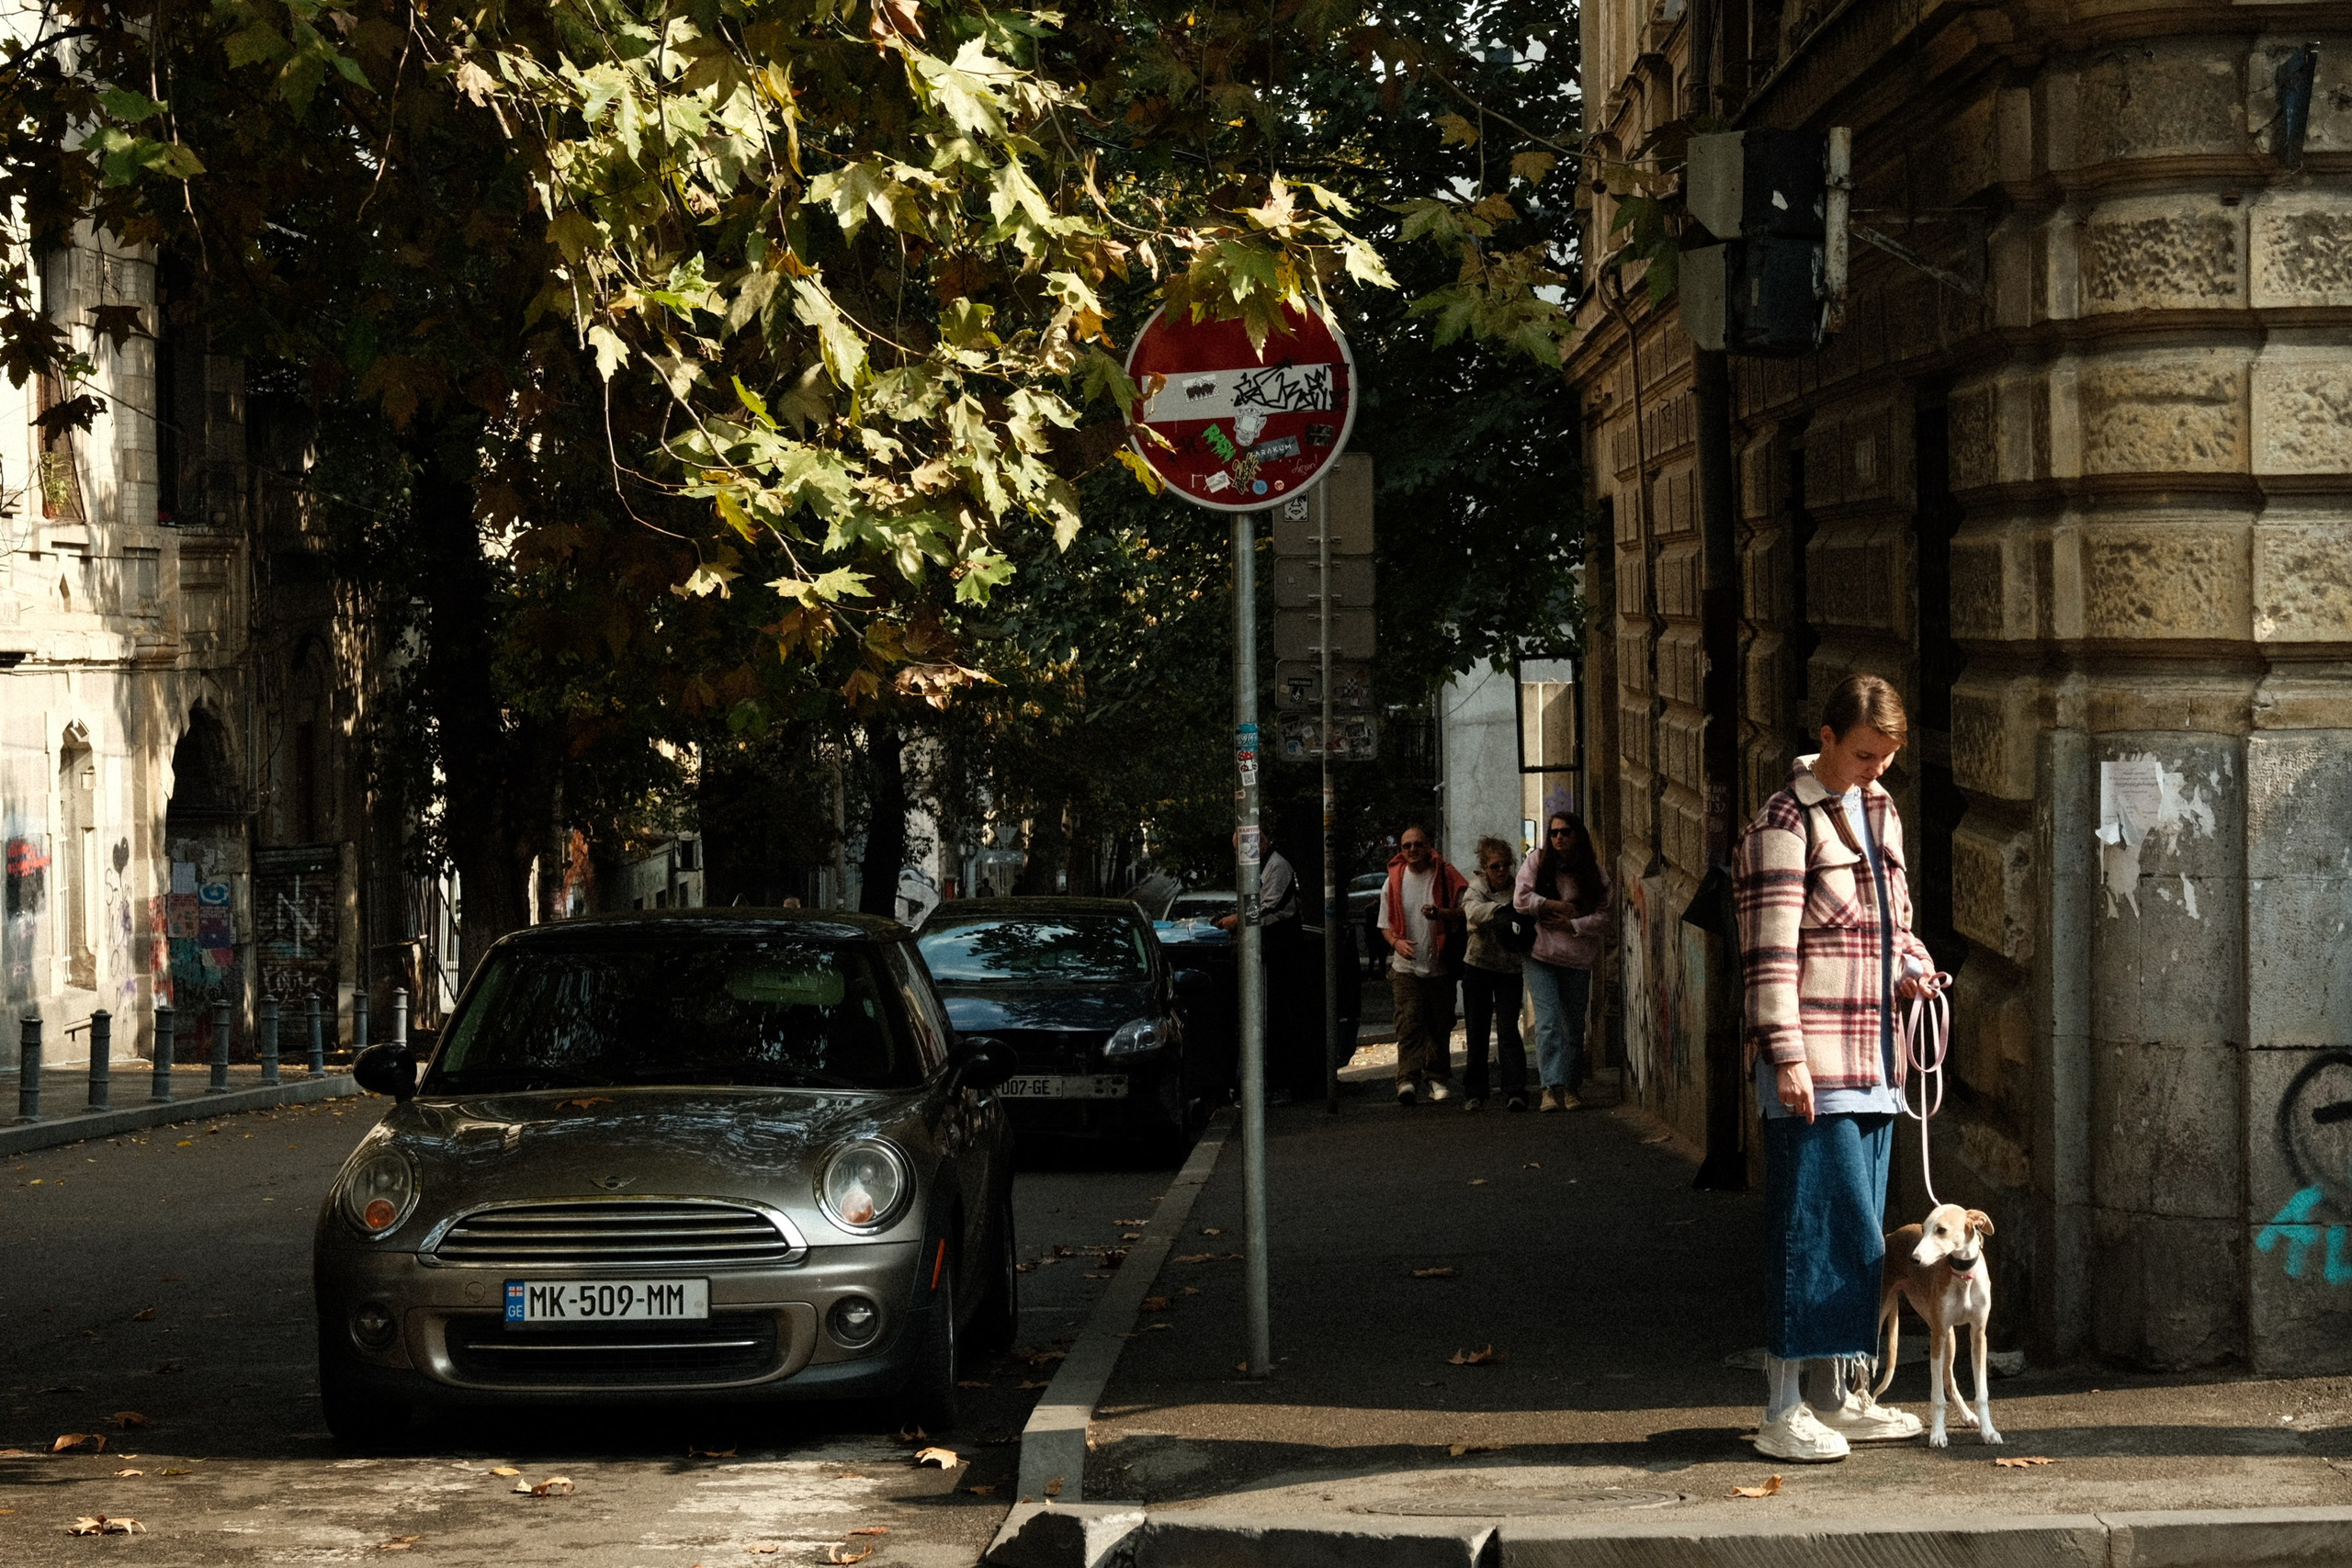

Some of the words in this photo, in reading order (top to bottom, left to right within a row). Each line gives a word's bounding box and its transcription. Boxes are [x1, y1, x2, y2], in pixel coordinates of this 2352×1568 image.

[1254, 443, 1292, 458] ARAKUM
[997, 1079, 1051, 1095] -007-GE
[529, 1284, 684, 1317] MK-509-MM
[508, 1304, 523, 1317] GE
